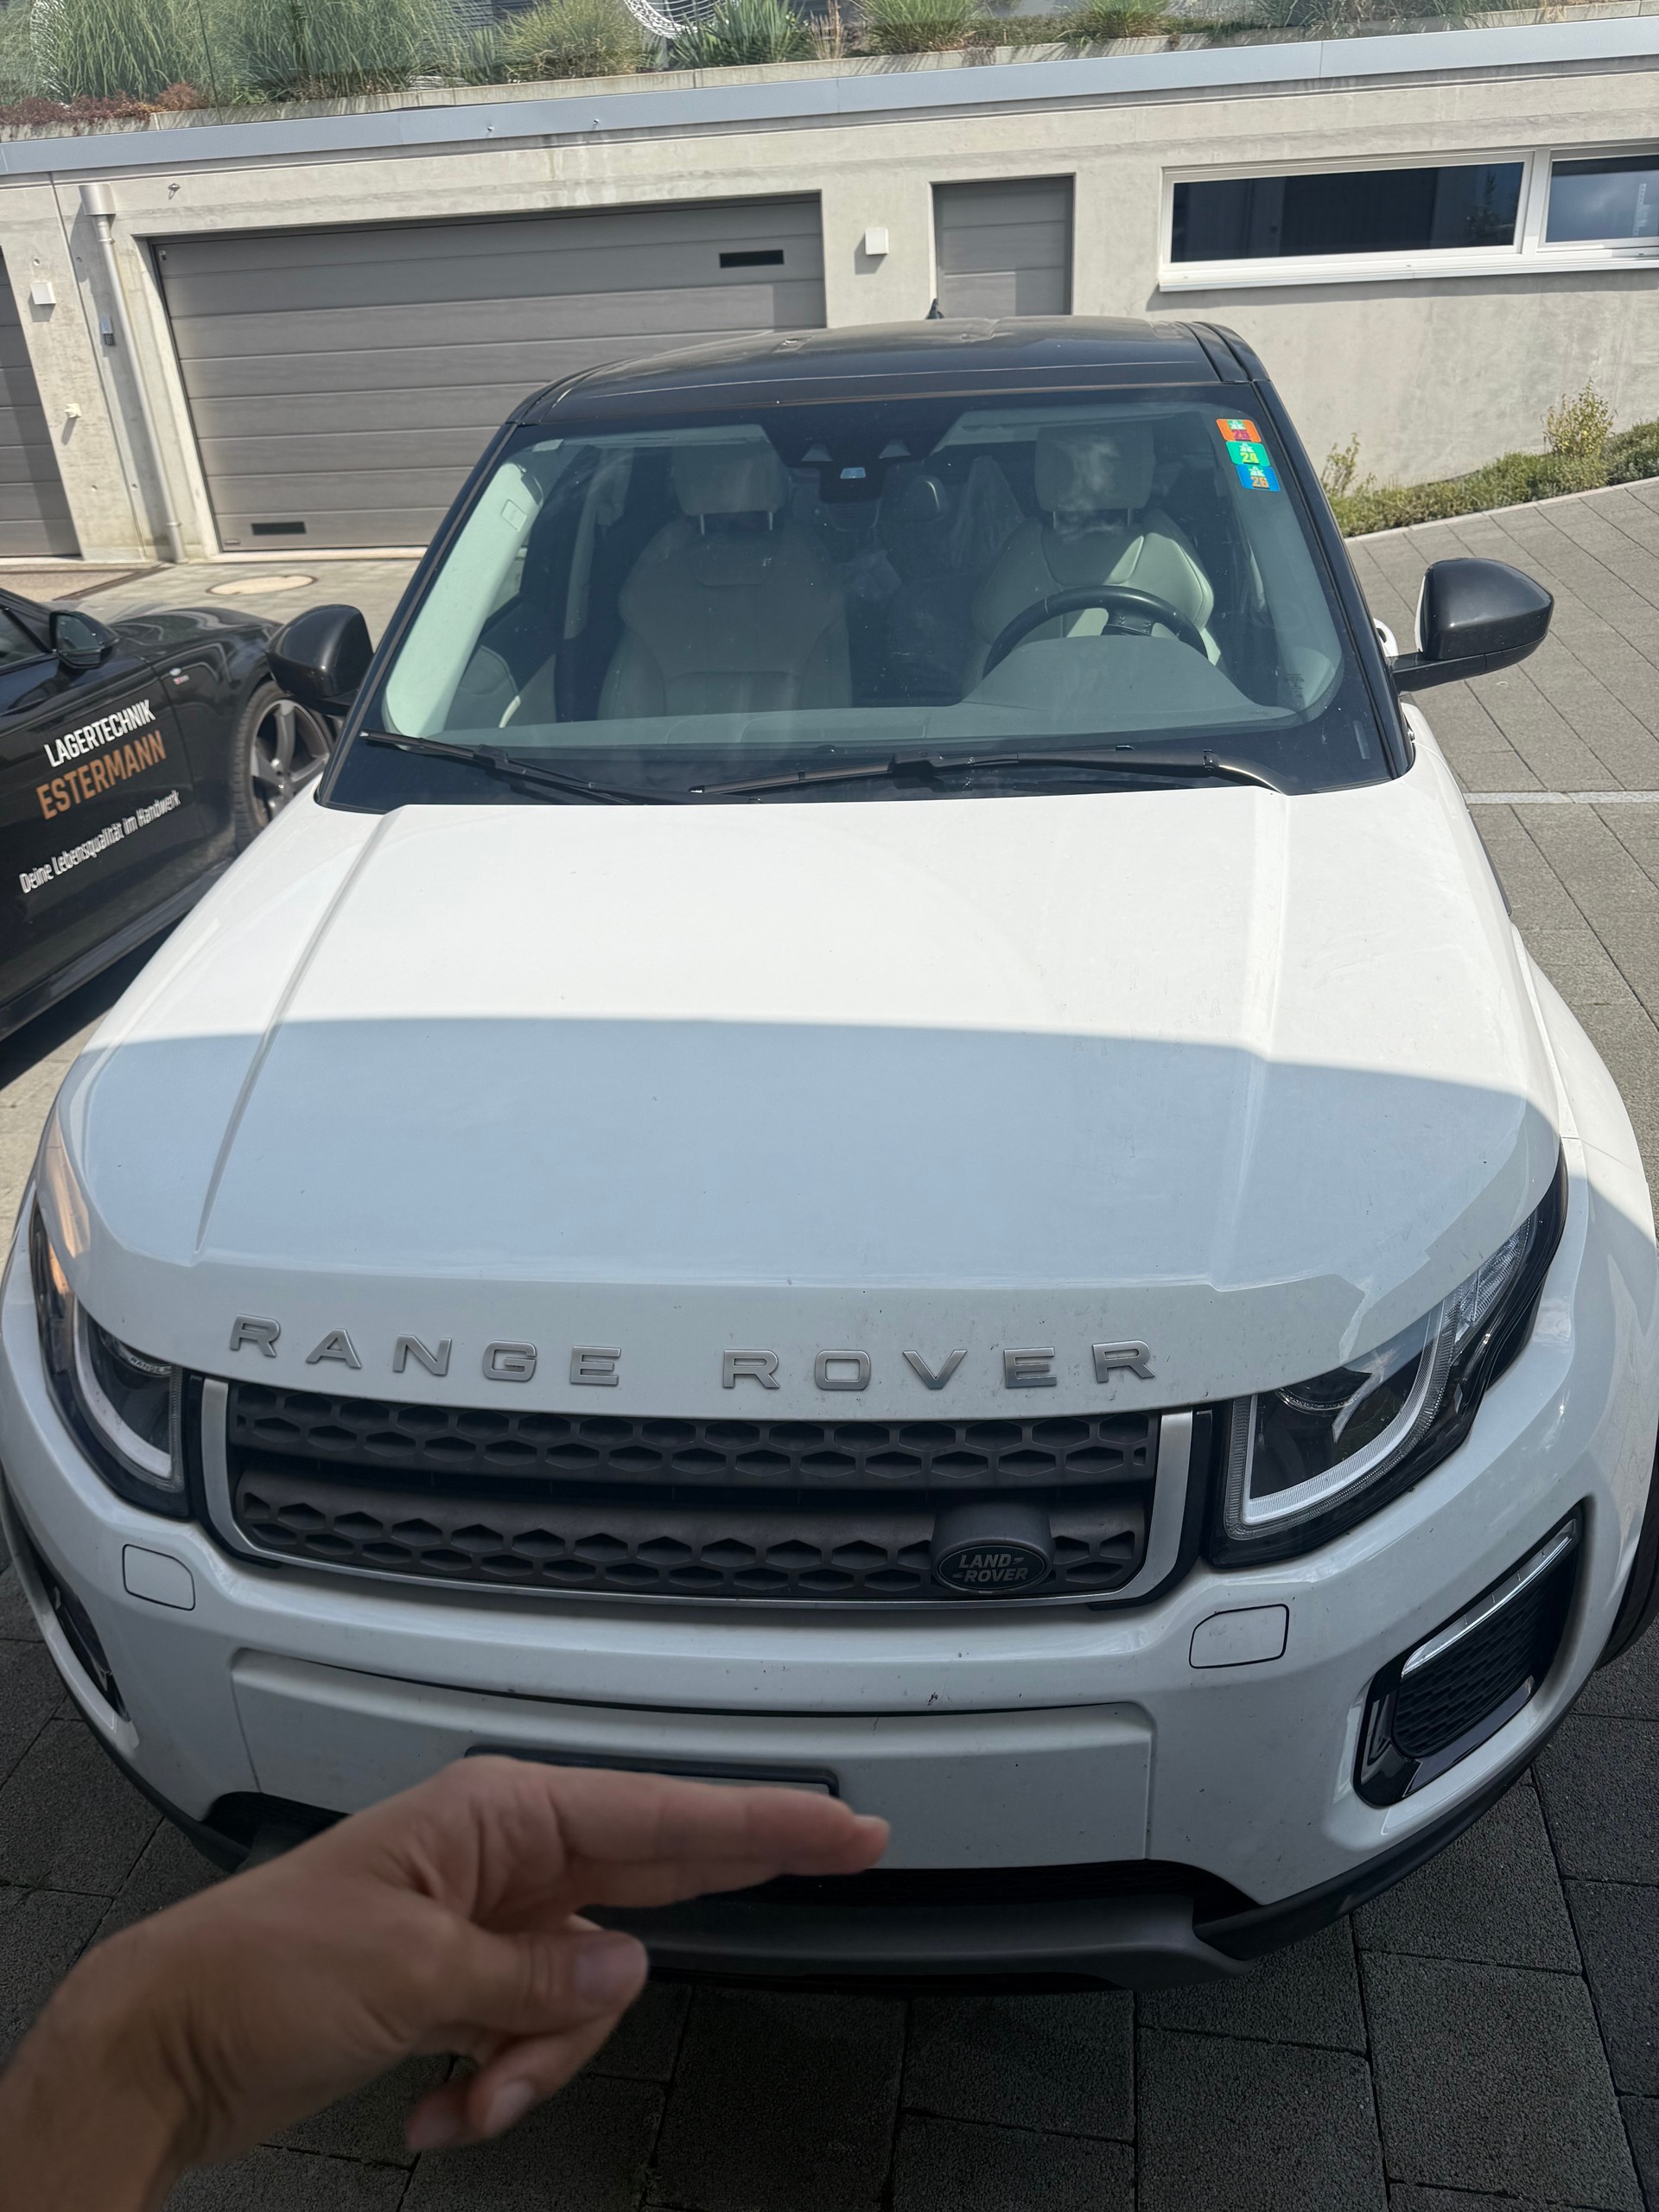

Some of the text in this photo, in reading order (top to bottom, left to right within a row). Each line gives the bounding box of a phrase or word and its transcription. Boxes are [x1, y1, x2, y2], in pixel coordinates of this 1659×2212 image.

[1240, 452, 1260, 463] 24
[44, 699, 156, 767] LAGERTECHNIK
[35, 730, 167, 820] ESTERMANN
[19, 789, 181, 893] Deine Lebensqualität im Handwerk
[229, 1313, 1156, 1390] RANGE ROVER
[958, 1554, 1012, 1568] LAND
[963, 1567, 1029, 1583] ROVER
